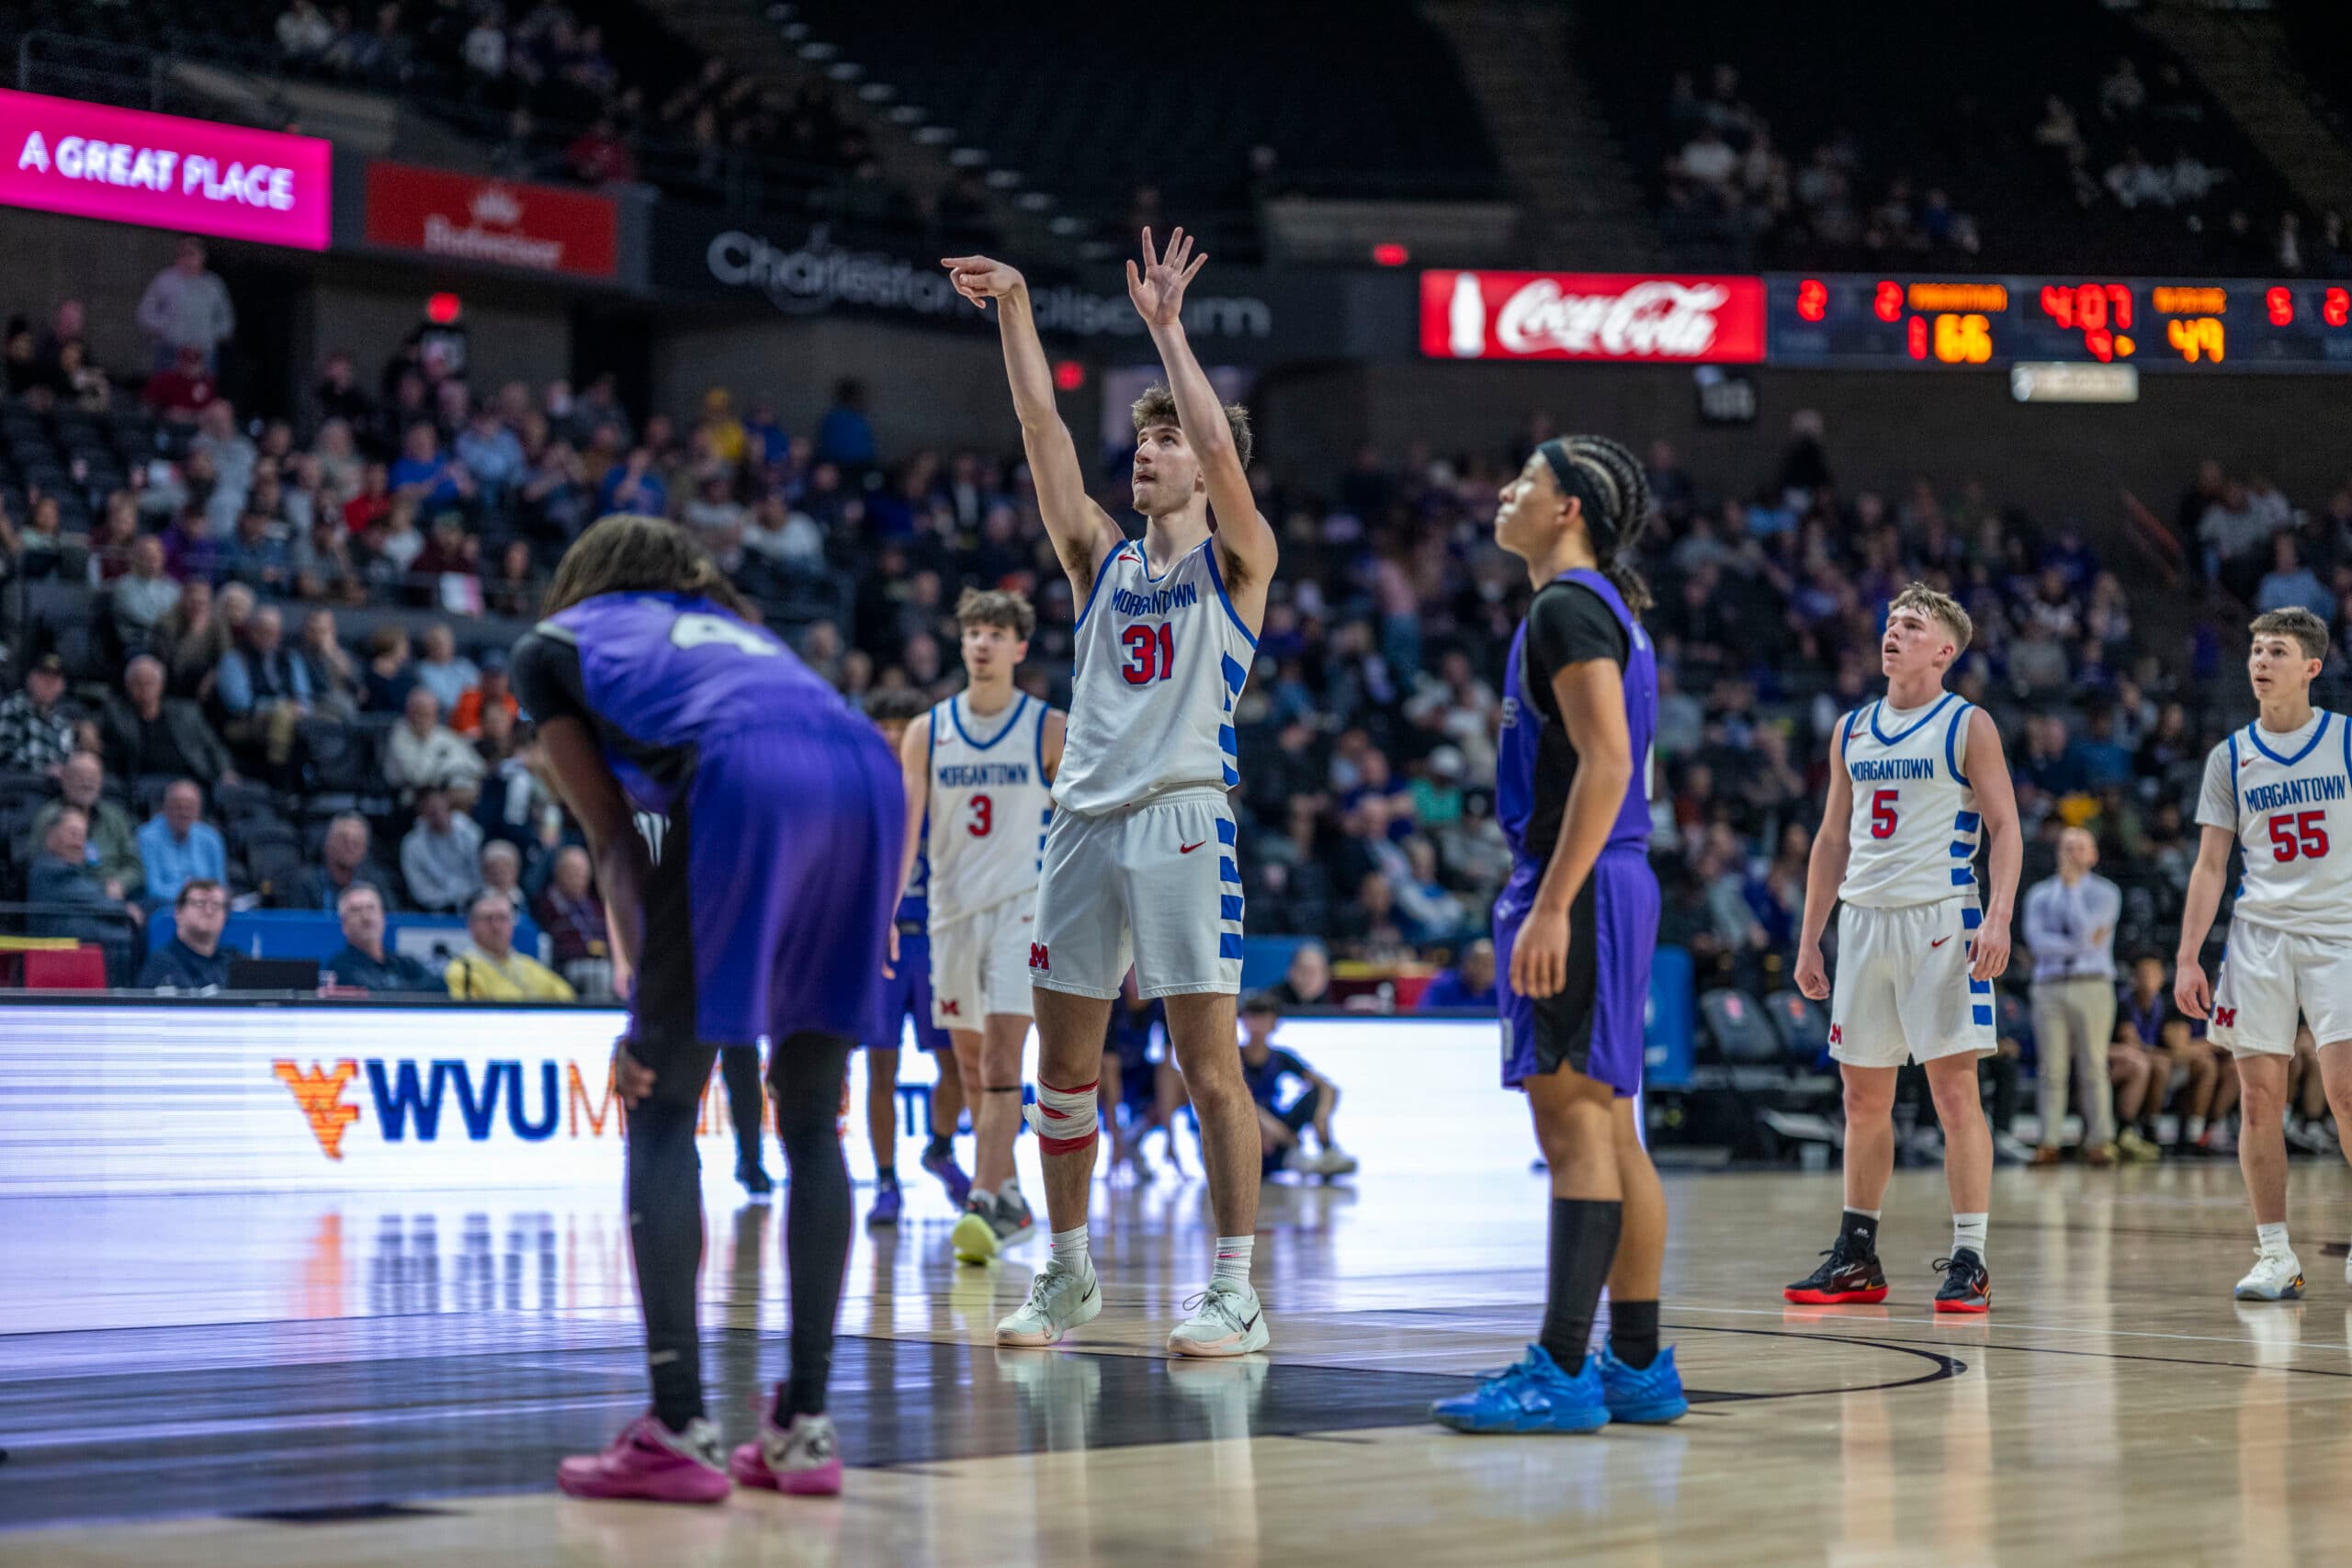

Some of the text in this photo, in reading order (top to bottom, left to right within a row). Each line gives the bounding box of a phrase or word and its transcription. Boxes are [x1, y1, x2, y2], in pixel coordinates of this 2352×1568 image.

[17, 130, 296, 211] A GREAT PLACE
[1122, 622, 1174, 685] 31
[1850, 758, 1934, 782] MORGANTOWN
[967, 794, 993, 839] 3
[1871, 789, 1899, 840] 5
[2245, 774, 2346, 814] MORGANTOWN
[2268, 809, 2330, 863] 55
[1028, 942, 1050, 971] M
[2215, 1005, 2238, 1029] M
